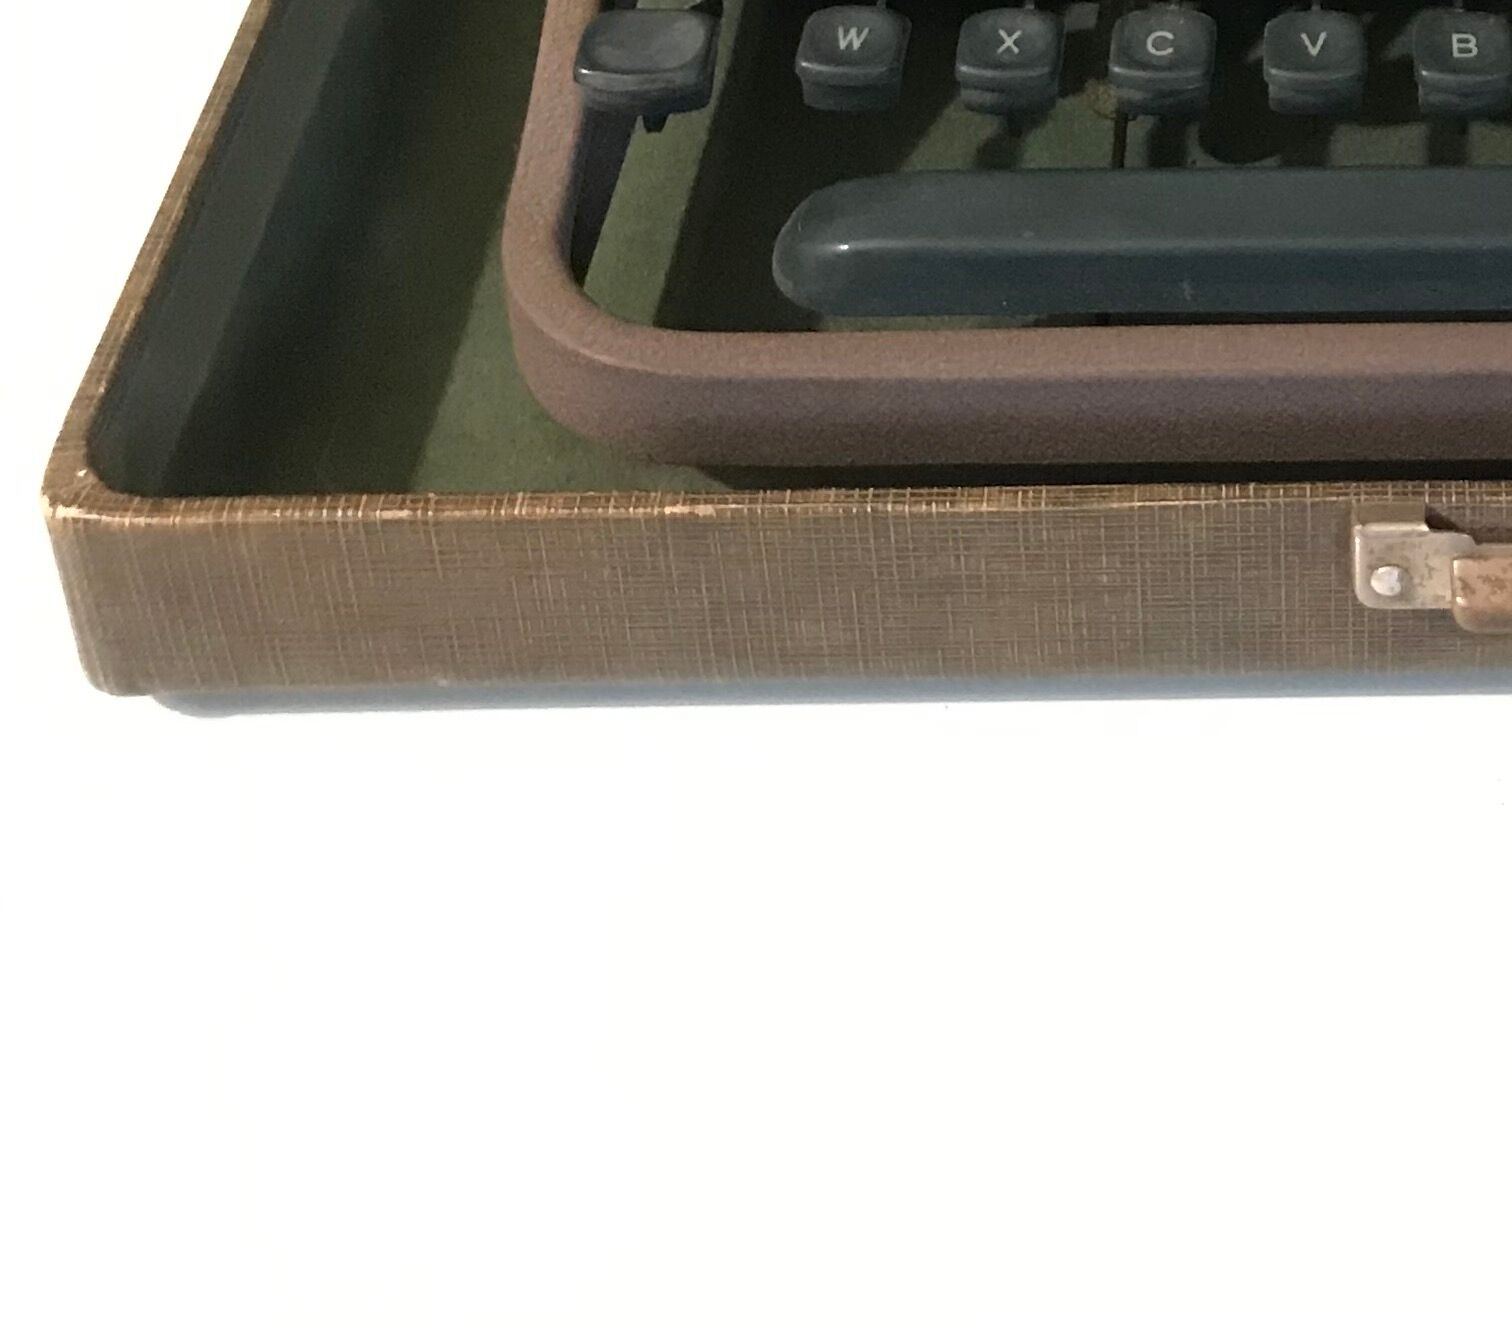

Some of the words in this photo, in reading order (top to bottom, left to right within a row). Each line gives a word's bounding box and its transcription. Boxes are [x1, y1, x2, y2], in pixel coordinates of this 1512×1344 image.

[837, 26, 870, 51] W
[997, 29, 1022, 55] X
[1146, 30, 1175, 56] C
[1300, 31, 1328, 57] V
[1451, 33, 1478, 58] B
